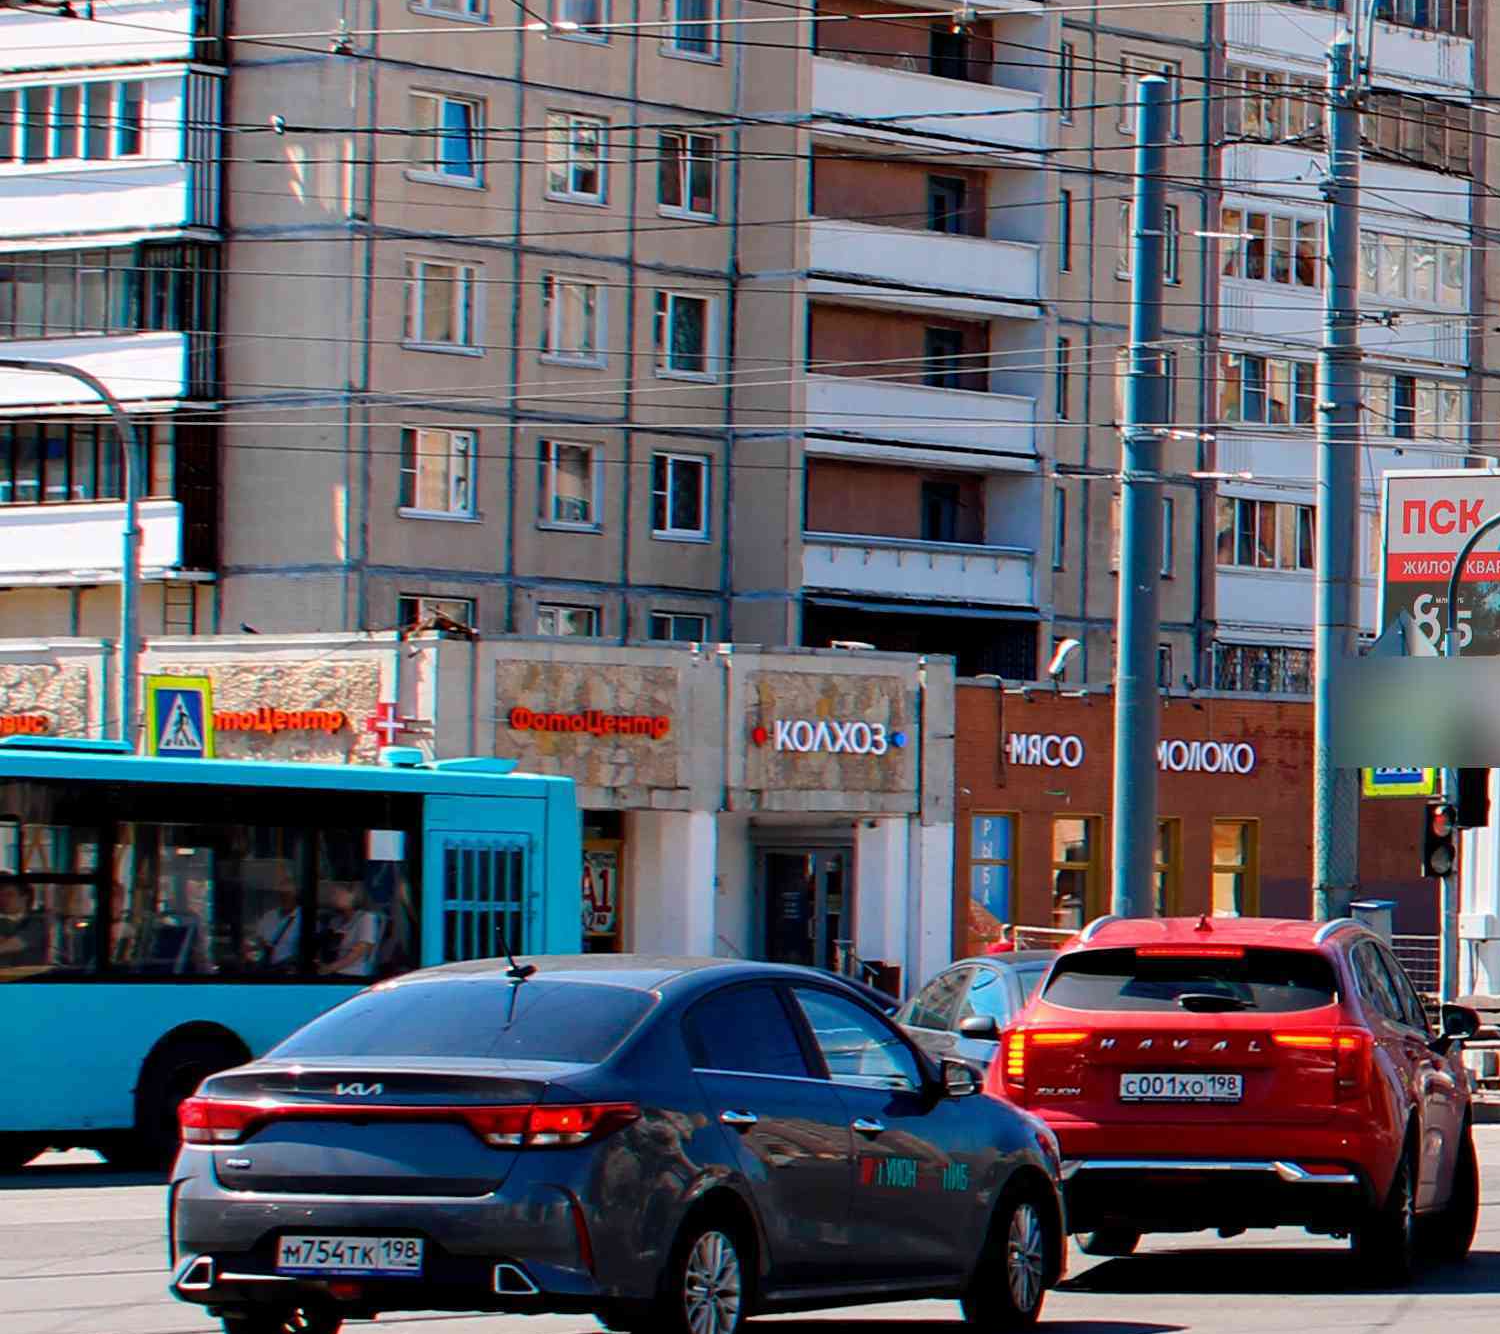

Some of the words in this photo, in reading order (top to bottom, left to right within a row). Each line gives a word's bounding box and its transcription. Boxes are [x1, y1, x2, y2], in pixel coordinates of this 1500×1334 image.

[1402, 498, 1484, 535] ПСК
[213, 708, 347, 735] тоЦентр
[509, 706, 670, 740] ФотоЦентр
[775, 719, 889, 756] КОЛХОЗ
[1009, 733, 1084, 768] МЯСО
[1100, 1038, 1261, 1052] HAVAL
[335, 1082, 384, 1096] KIA
[1125, 1075, 1204, 1096] С001ХО
[1208, 1075, 1237, 1092] 198
[283, 1240, 375, 1265] М754ТК
[381, 1241, 416, 1259] 198
